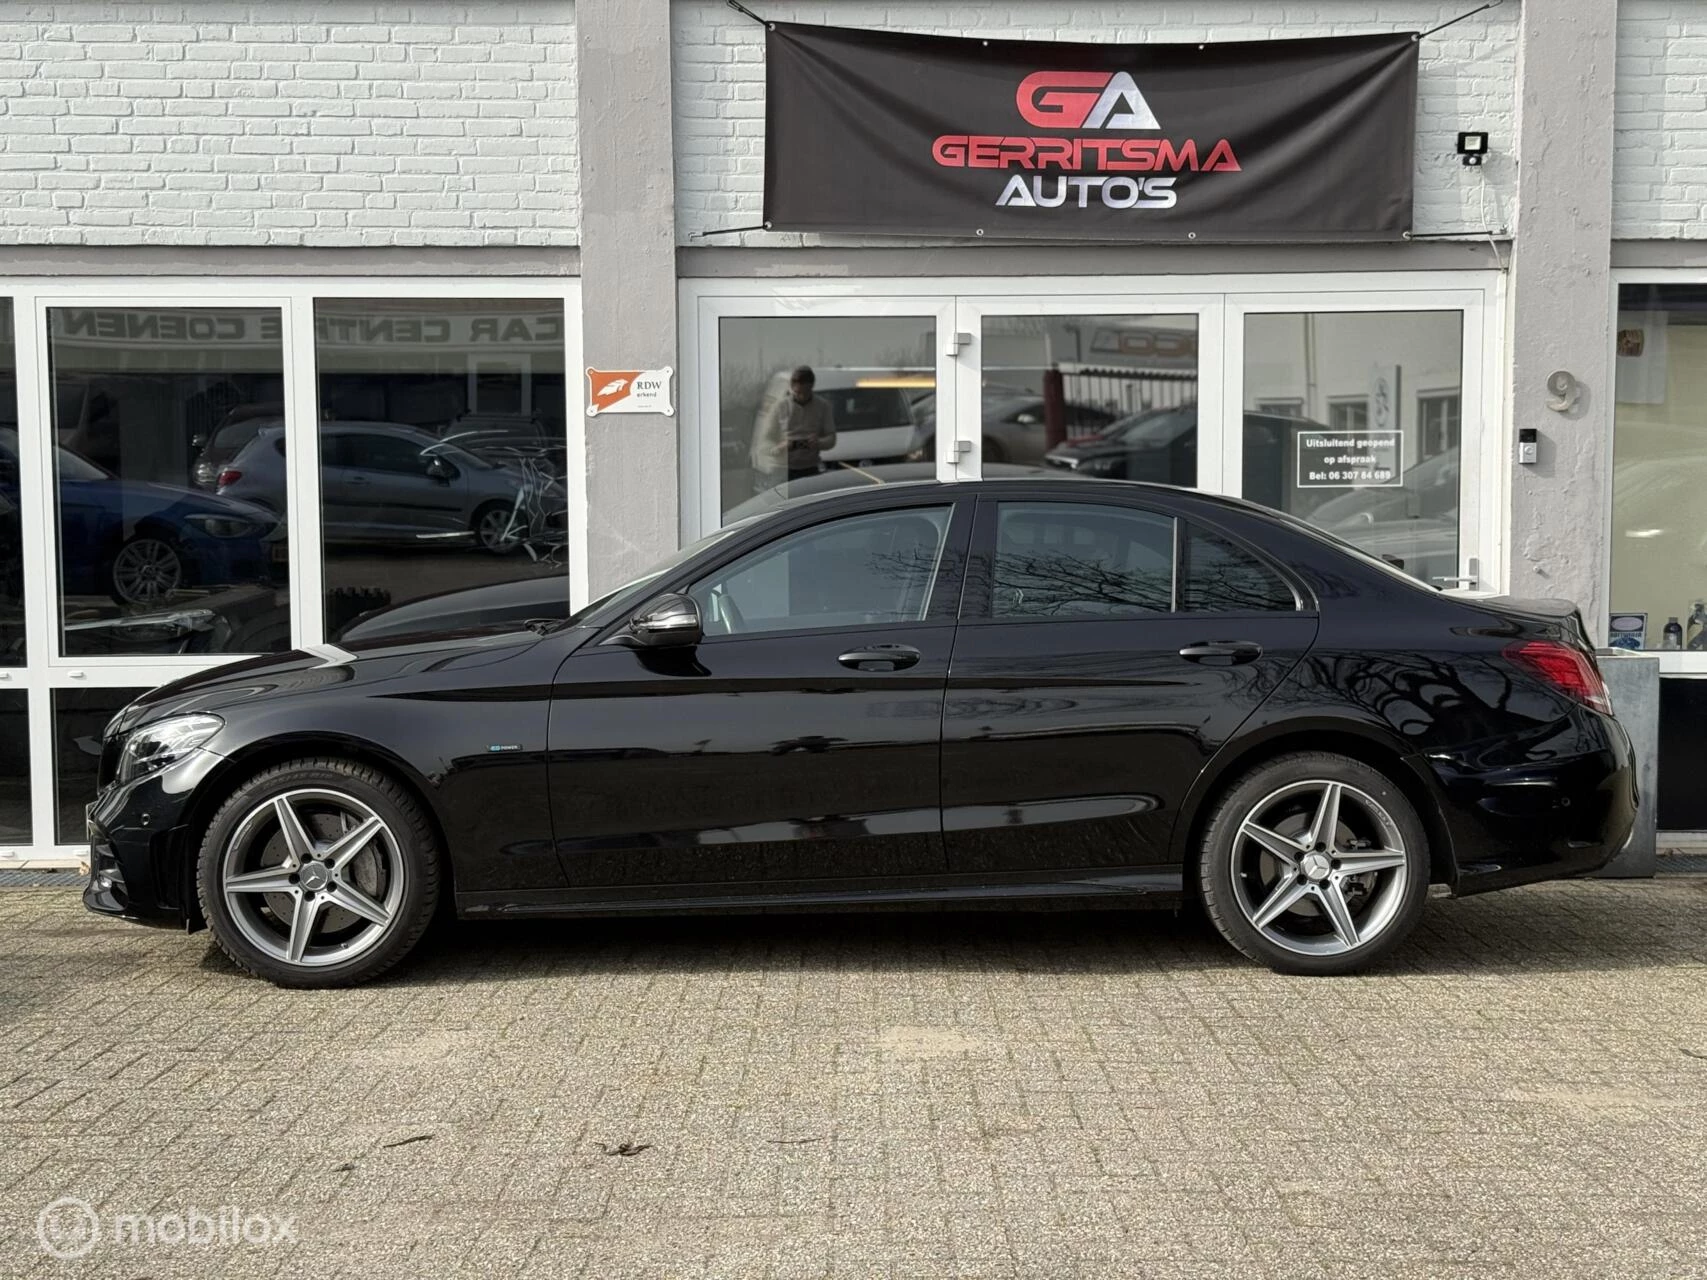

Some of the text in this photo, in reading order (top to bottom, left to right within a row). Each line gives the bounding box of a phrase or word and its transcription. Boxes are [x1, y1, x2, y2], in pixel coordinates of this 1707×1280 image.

[1015, 70, 1161, 129] GA
[932, 134, 1242, 172] GERRITSMA
[995, 174, 1178, 209] AUTO'S
[636, 381, 661, 390] RDW
[1547, 370, 1578, 412] 9
[1306, 438, 1396, 449] Uitsluitend geopend
[1323, 455, 1377, 465] op afspraak
[1309, 471, 1327, 480] Bel:
[1342, 471, 1359, 480] 307
